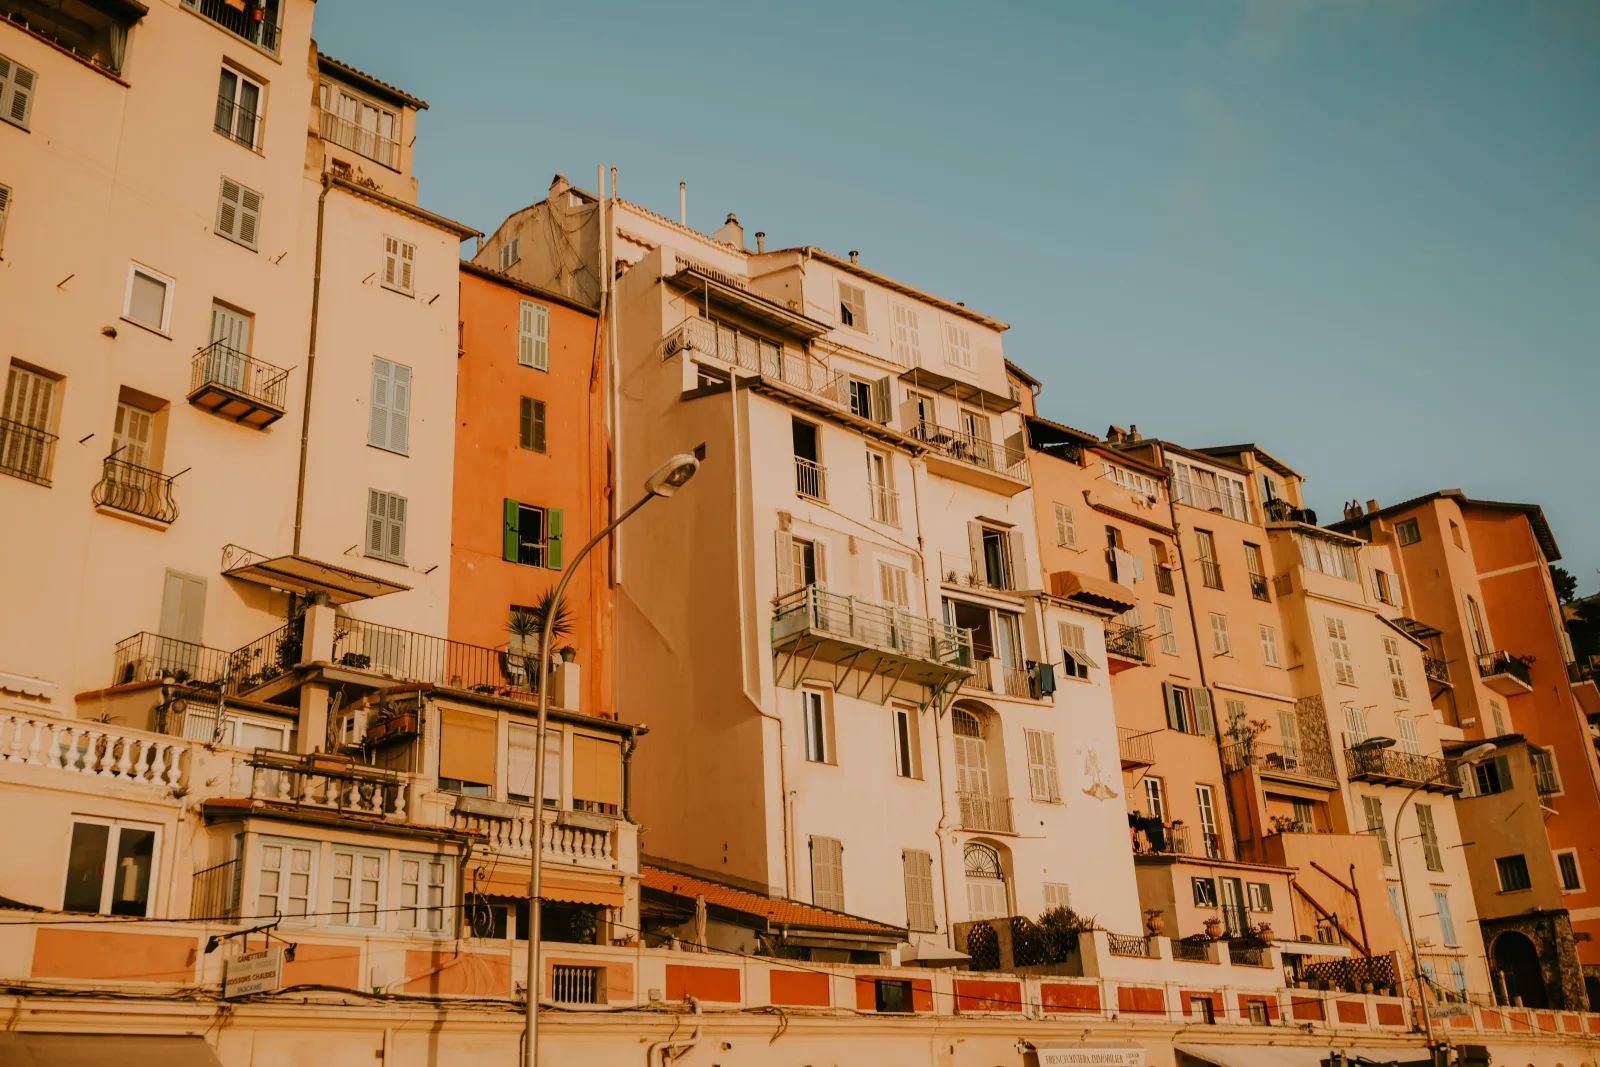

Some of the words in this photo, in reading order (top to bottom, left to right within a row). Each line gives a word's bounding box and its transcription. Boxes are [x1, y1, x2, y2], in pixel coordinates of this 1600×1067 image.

[226, 975, 251, 986] BOISSONS
[252, 970, 276, 981] CHAUDES
[1045, 1055, 1069, 1064] FRENCH
[1069, 1055, 1090, 1063] RIVIERA
[1091, 1055, 1124, 1063] IMMOBILIER
